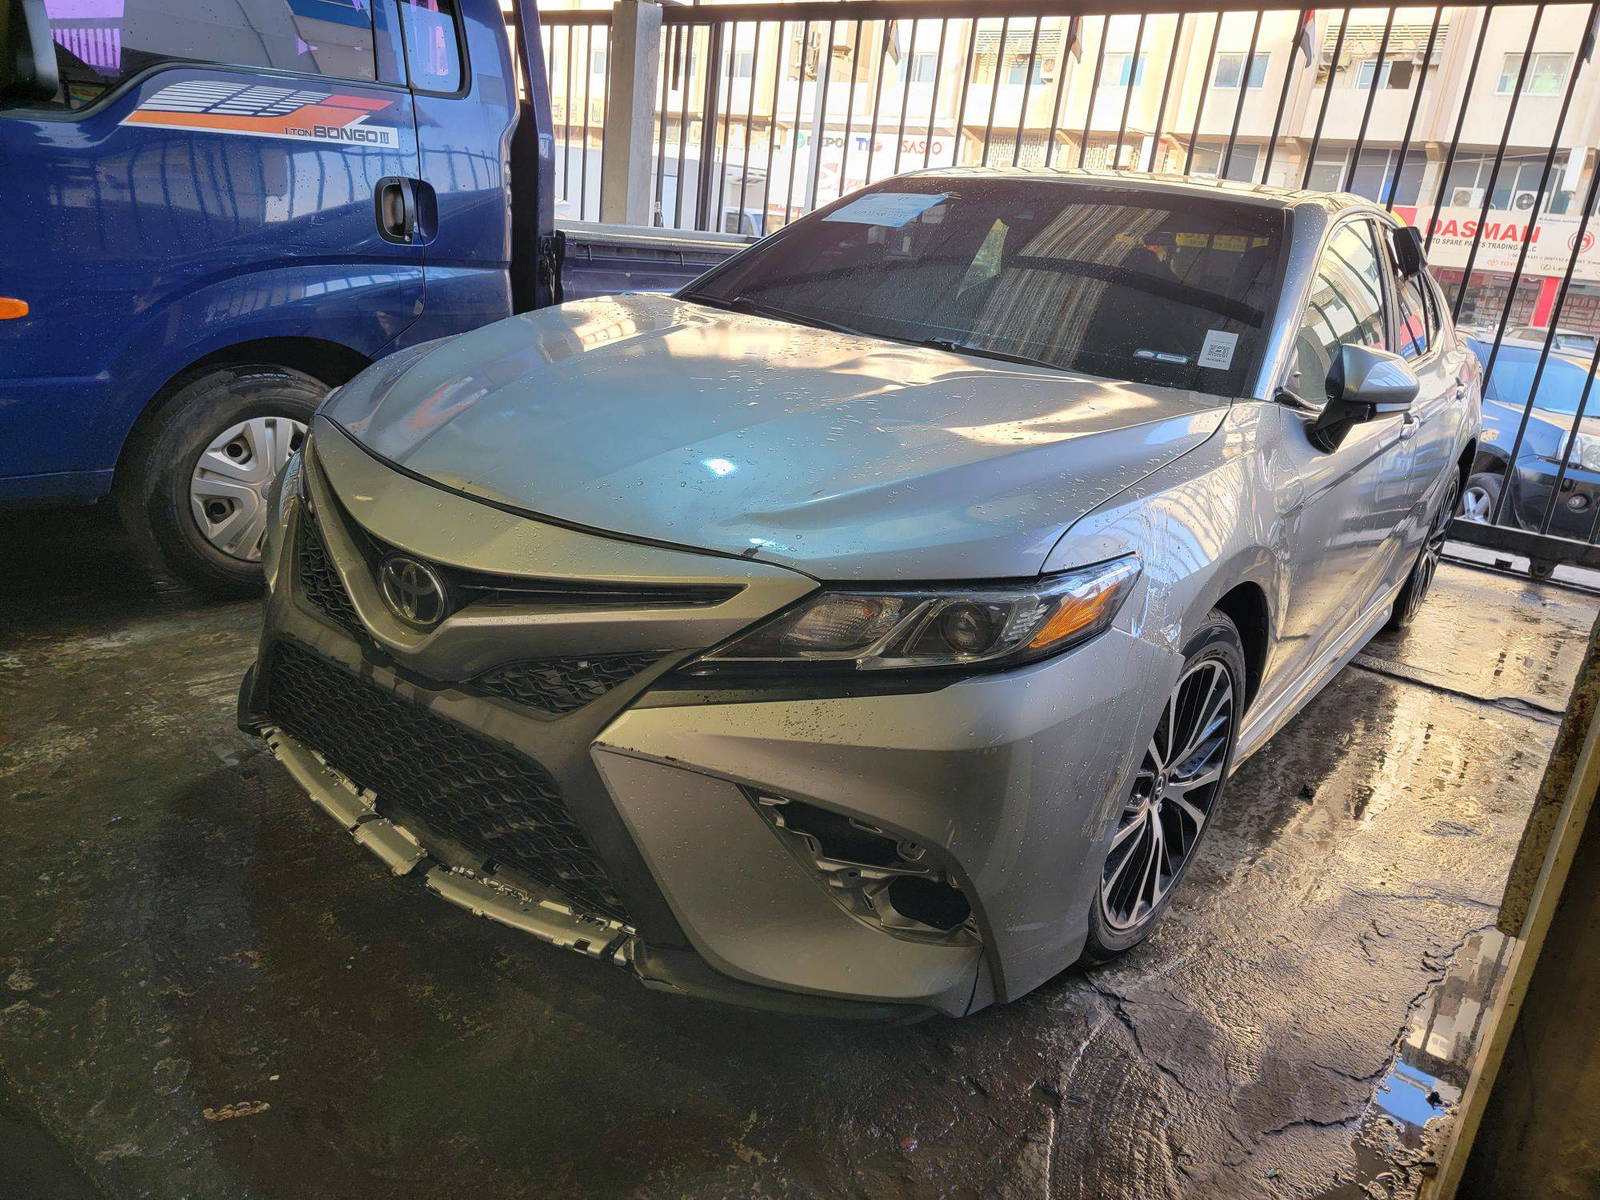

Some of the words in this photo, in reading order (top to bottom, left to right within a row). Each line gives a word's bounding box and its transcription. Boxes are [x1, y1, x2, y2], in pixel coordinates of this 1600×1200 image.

[290, 128, 312, 137] TON
[314, 125, 378, 143] BONGO
[1425, 218, 1541, 243] DASMAN
[1441, 238, 1462, 246] SPARE
[1488, 241, 1518, 250] TRADING
